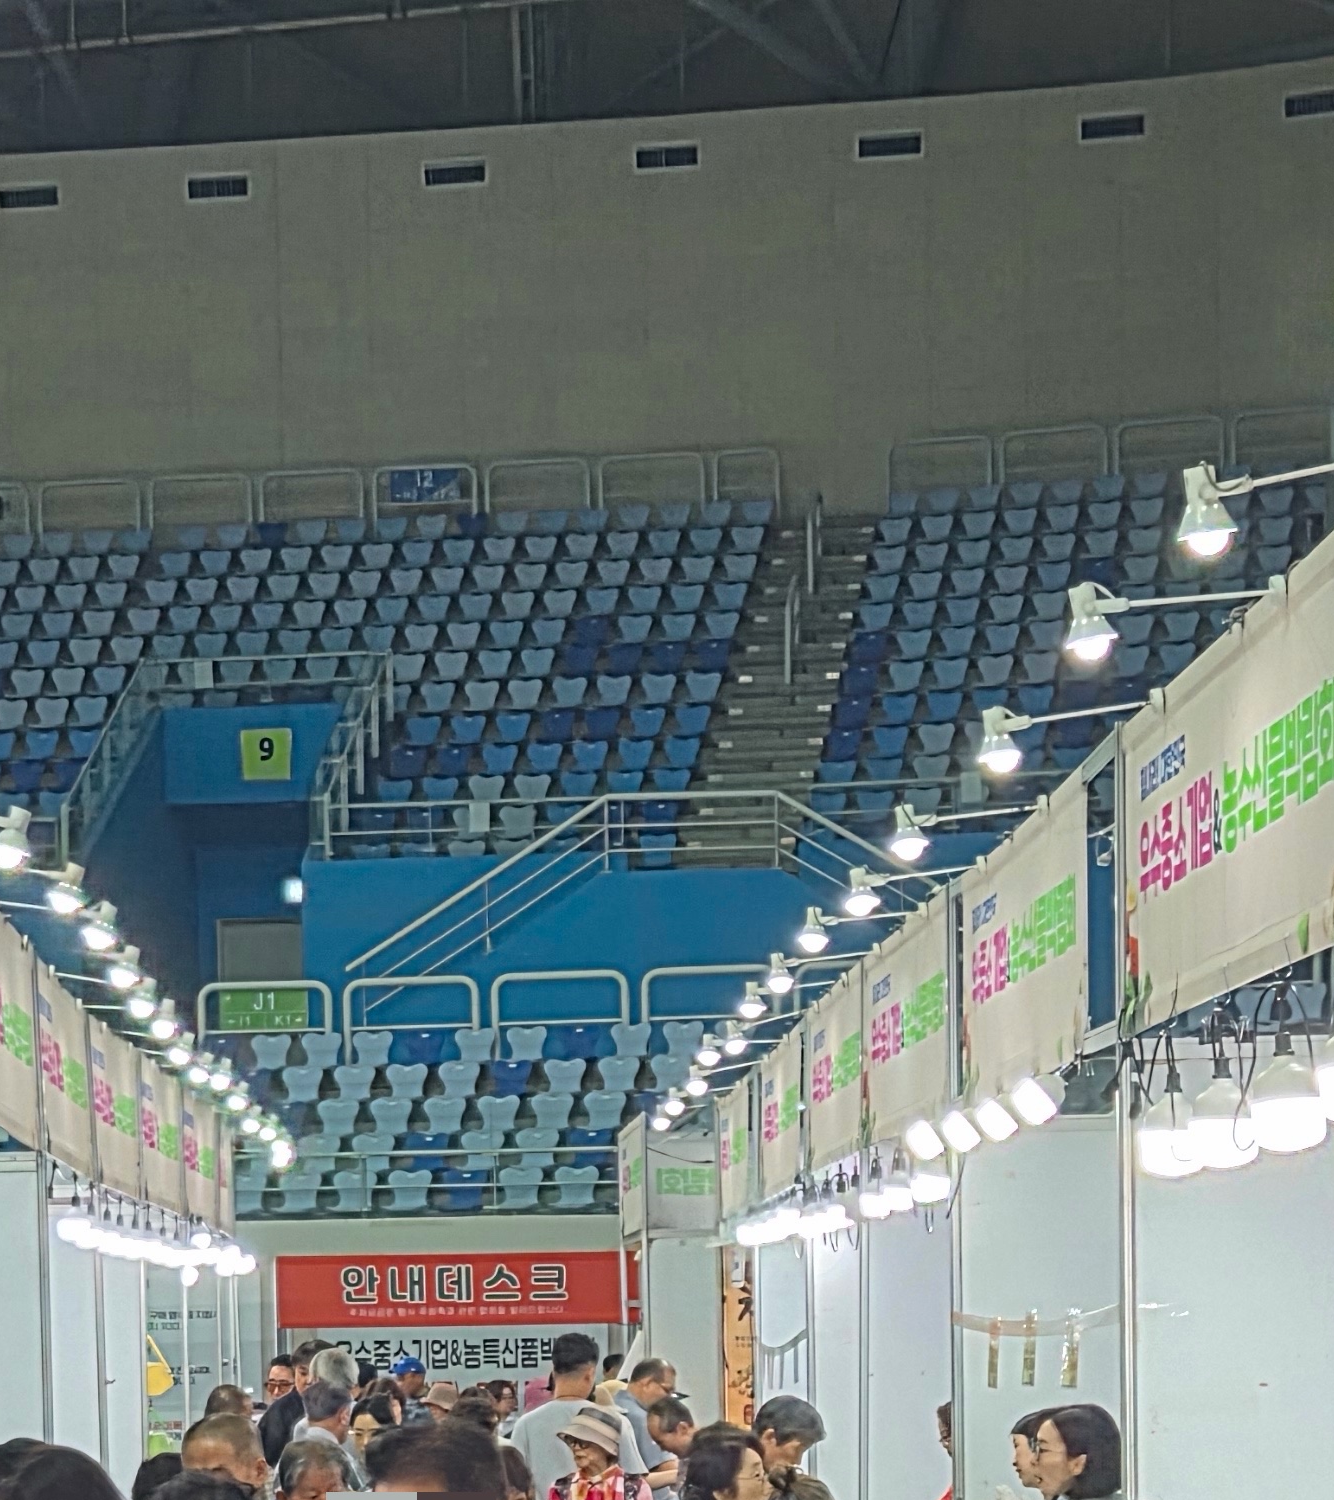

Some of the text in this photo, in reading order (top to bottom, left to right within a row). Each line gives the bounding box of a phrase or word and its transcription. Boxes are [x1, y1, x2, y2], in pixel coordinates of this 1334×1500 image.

[259, 737, 275, 762] 9
[253, 991, 275, 1011] J1
[274, 1014, 291, 1026] K1
[340, 1263, 569, 1305] 안내데스크
